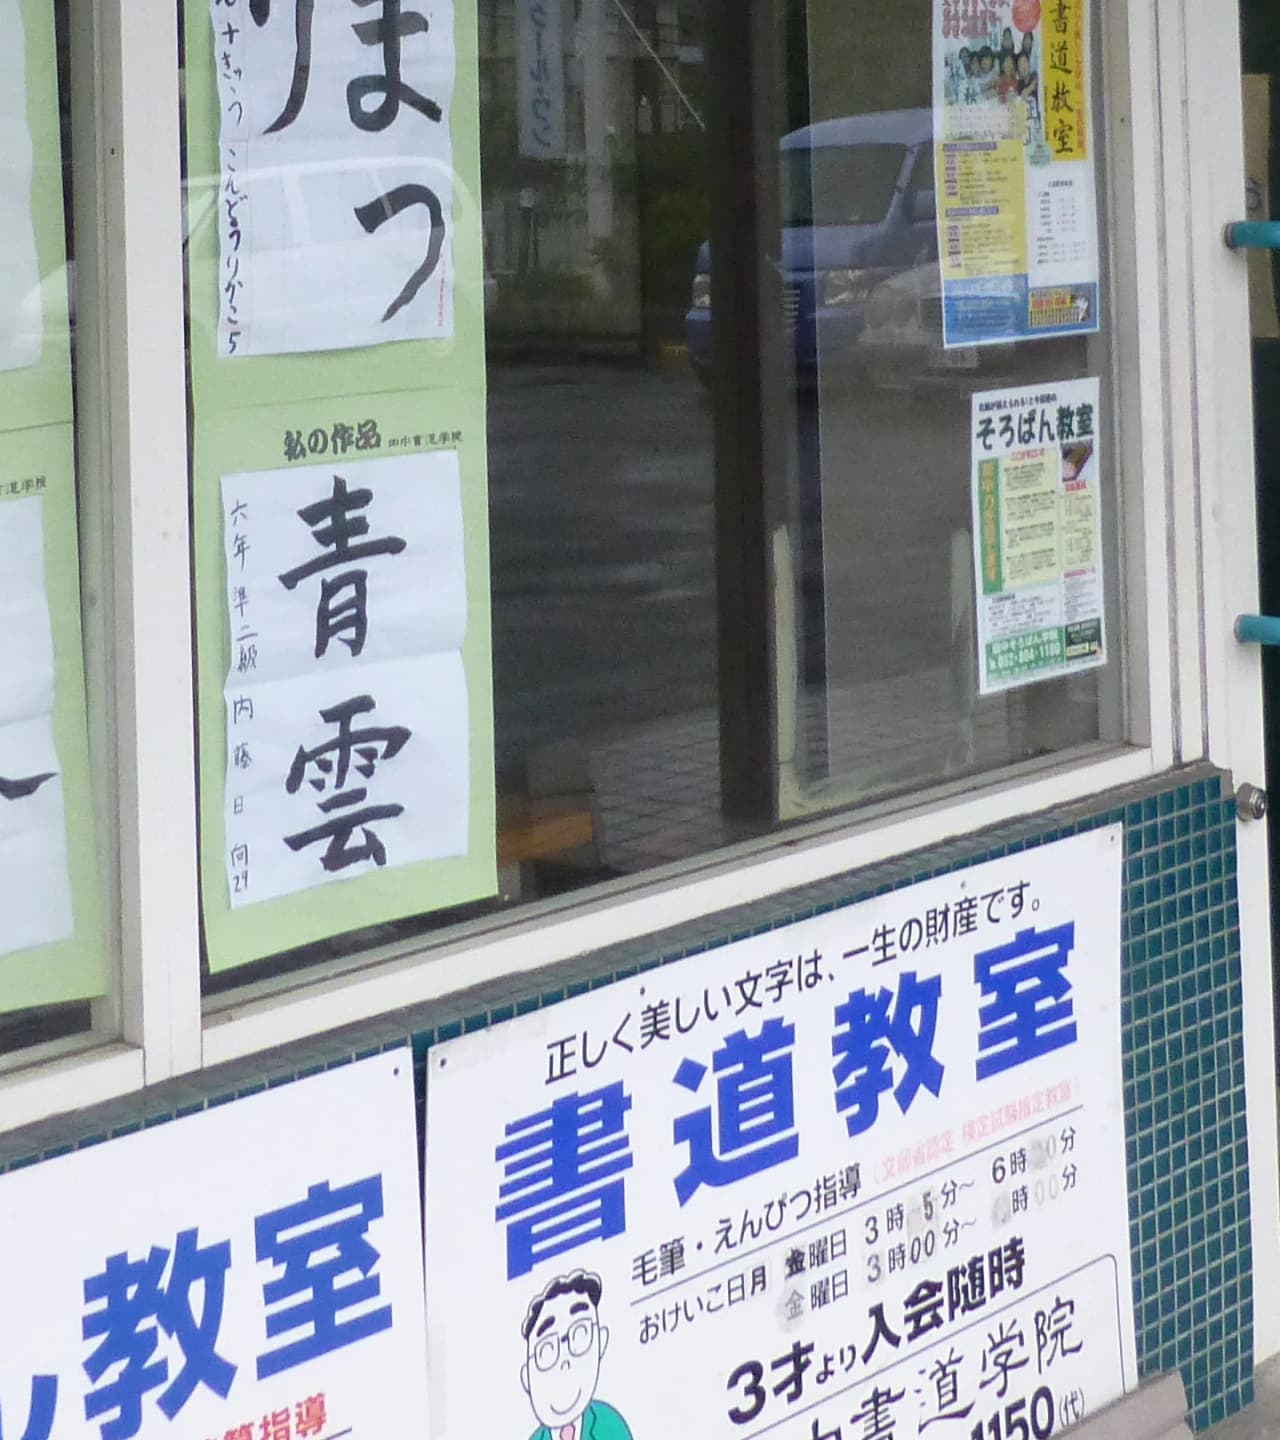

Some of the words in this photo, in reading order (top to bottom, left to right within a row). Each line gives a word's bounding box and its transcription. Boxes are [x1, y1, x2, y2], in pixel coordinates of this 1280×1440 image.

[283, 419, 382, 462] 私の作品
[976, 402, 1095, 451] そろばん教室
[278, 475, 413, 873] 青雲
[545, 880, 1042, 1085] 正しく美しい文字は、一生の財産です。
[494, 920, 1078, 1282] 書道教室
[631, 1162, 862, 1288] 毛筆・えんぴつ指導
[726, 1236, 1027, 1426] 3才より入会随時
